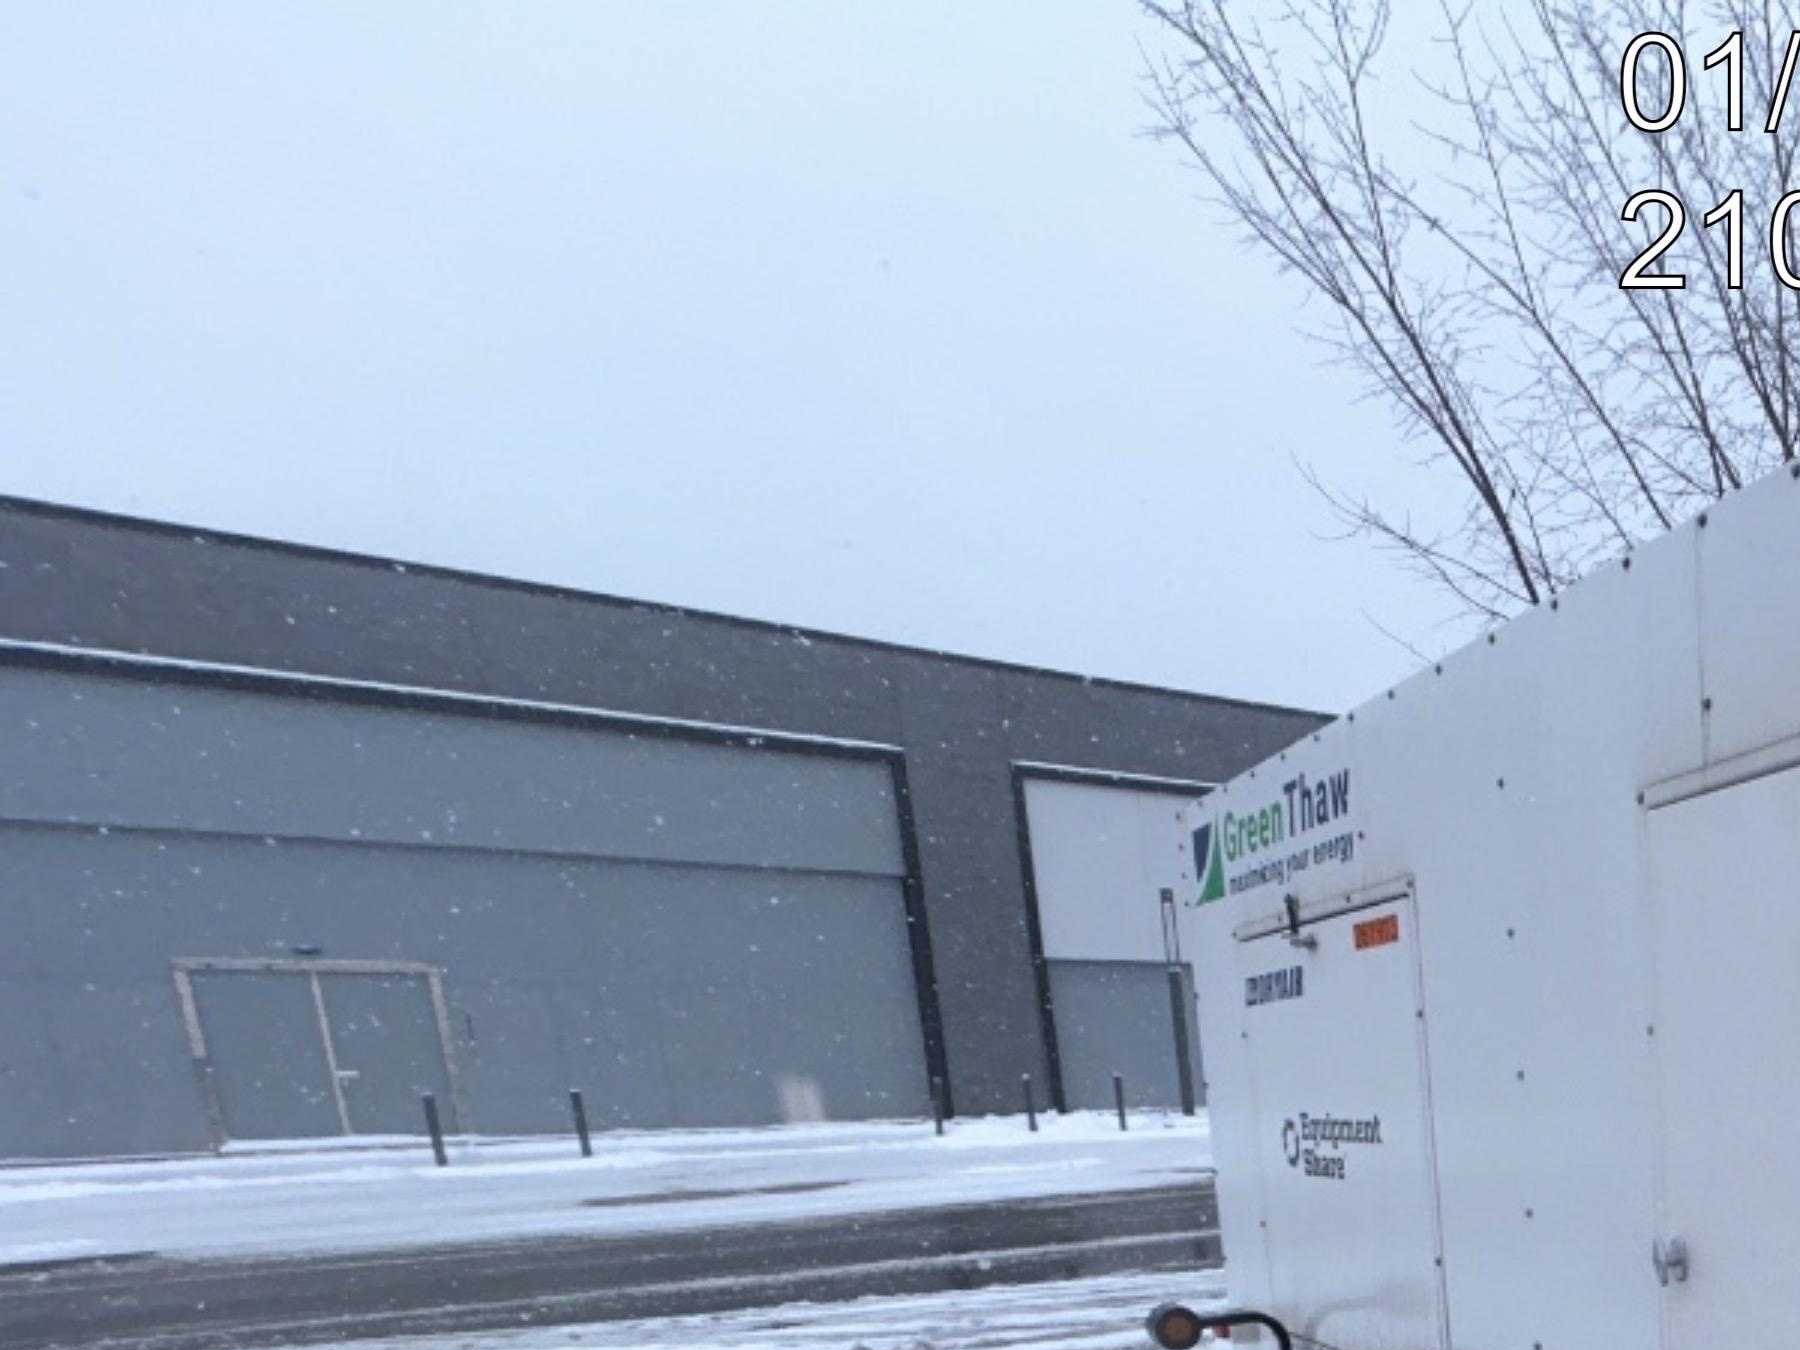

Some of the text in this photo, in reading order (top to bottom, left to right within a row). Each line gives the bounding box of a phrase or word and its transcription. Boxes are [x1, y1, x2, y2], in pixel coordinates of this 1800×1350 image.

[1223, 768, 1350, 861] Green Thaw
[1313, 832, 1354, 864] energy
[1299, 1112, 1383, 1150] Equipment
[1303, 1148, 1345, 1180] Share
